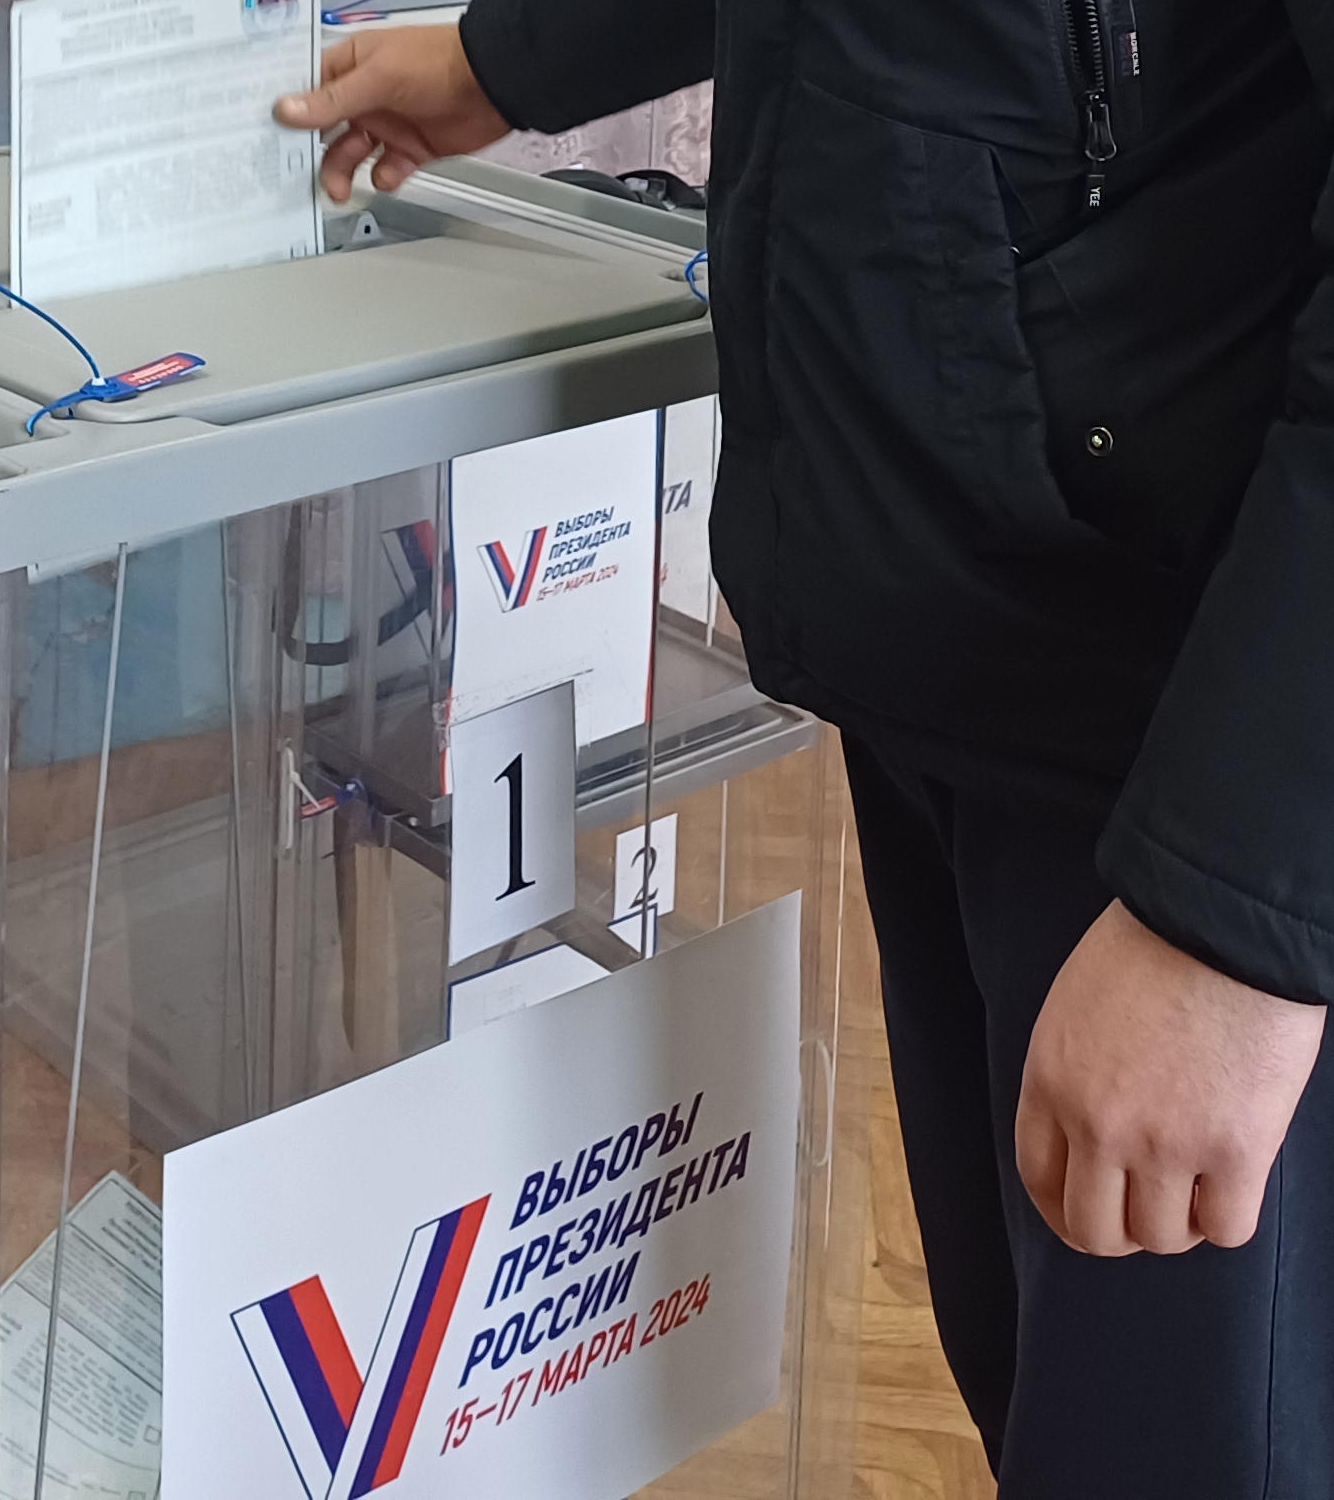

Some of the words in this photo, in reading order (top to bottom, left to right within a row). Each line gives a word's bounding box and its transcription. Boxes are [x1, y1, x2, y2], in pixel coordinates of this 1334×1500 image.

[542, 552, 598, 583] РОССИИ
[548, 521, 632, 561] ПРЕЗИДЕНТА
[553, 505, 615, 539] ВЫБОРЫ
[562, 572, 596, 596] МАРТА
[595, 562, 620, 585] 2024
[493, 752, 536, 902] 1
[628, 846, 659, 909] 2
[509, 1092, 704, 1231] ВЫБОРЫ
[484, 1132, 752, 1310] ПРЕЗИДЕНТА
[458, 1251, 642, 1389] РОССИИ
[531, 1318, 638, 1407] МАРТА
[639, 1273, 711, 1348] 2024
